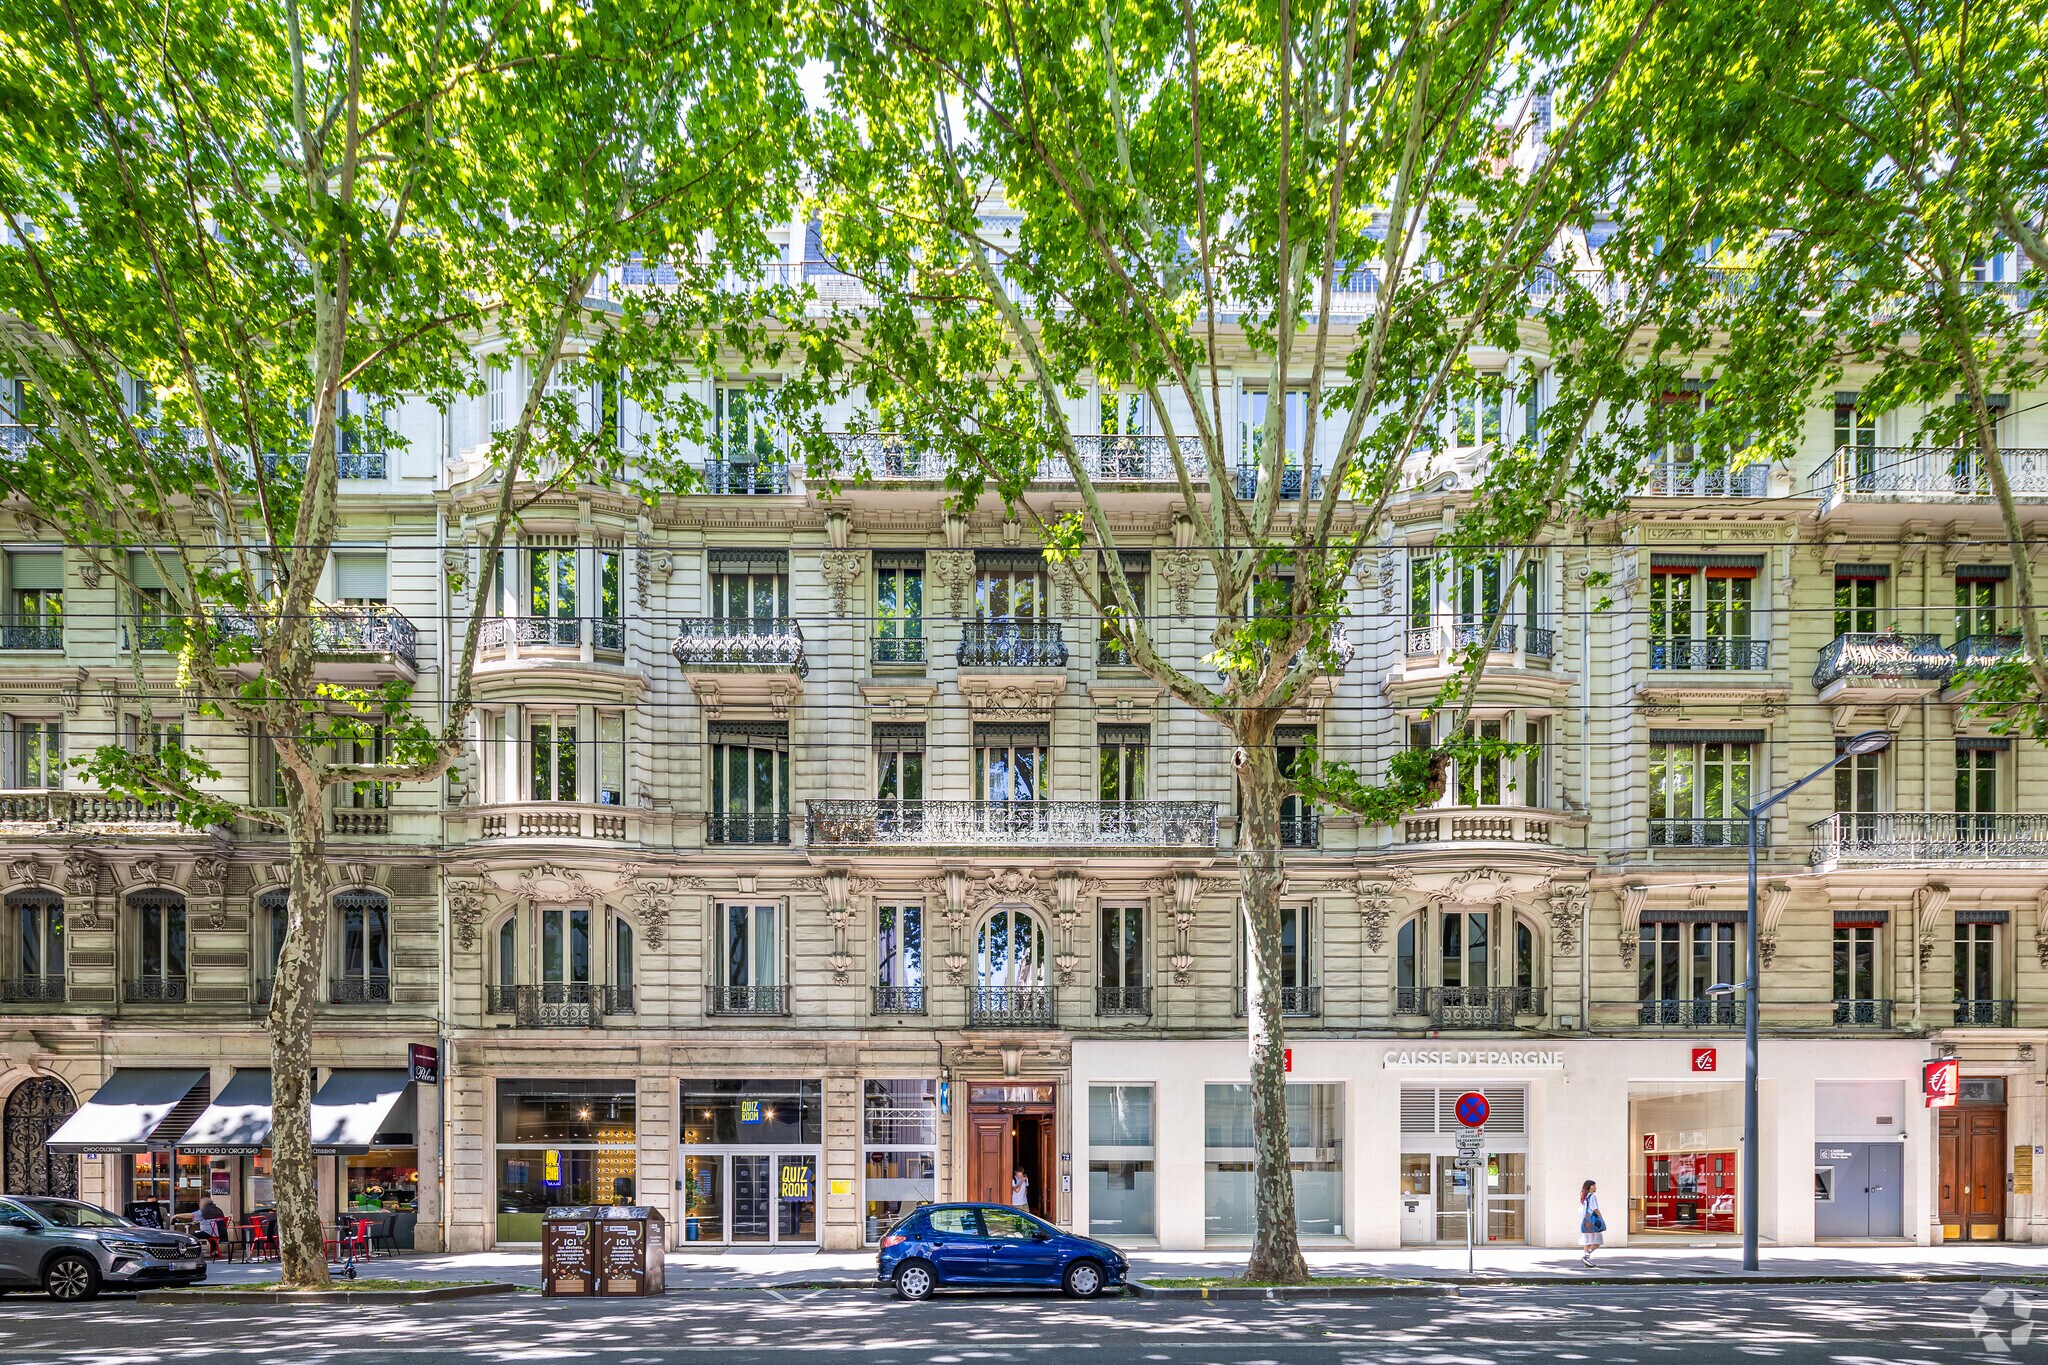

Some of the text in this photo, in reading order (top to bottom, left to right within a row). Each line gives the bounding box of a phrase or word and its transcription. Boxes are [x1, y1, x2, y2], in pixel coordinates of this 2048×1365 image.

[1383, 1051, 1564, 1064] CAISSE D'EPARGNE
[741, 1101, 758, 1111] QUIZ
[741, 1111, 758, 1121] ROOM
[782, 1165, 808, 1182] QUIZ
[782, 1183, 808, 1197] ROOM
